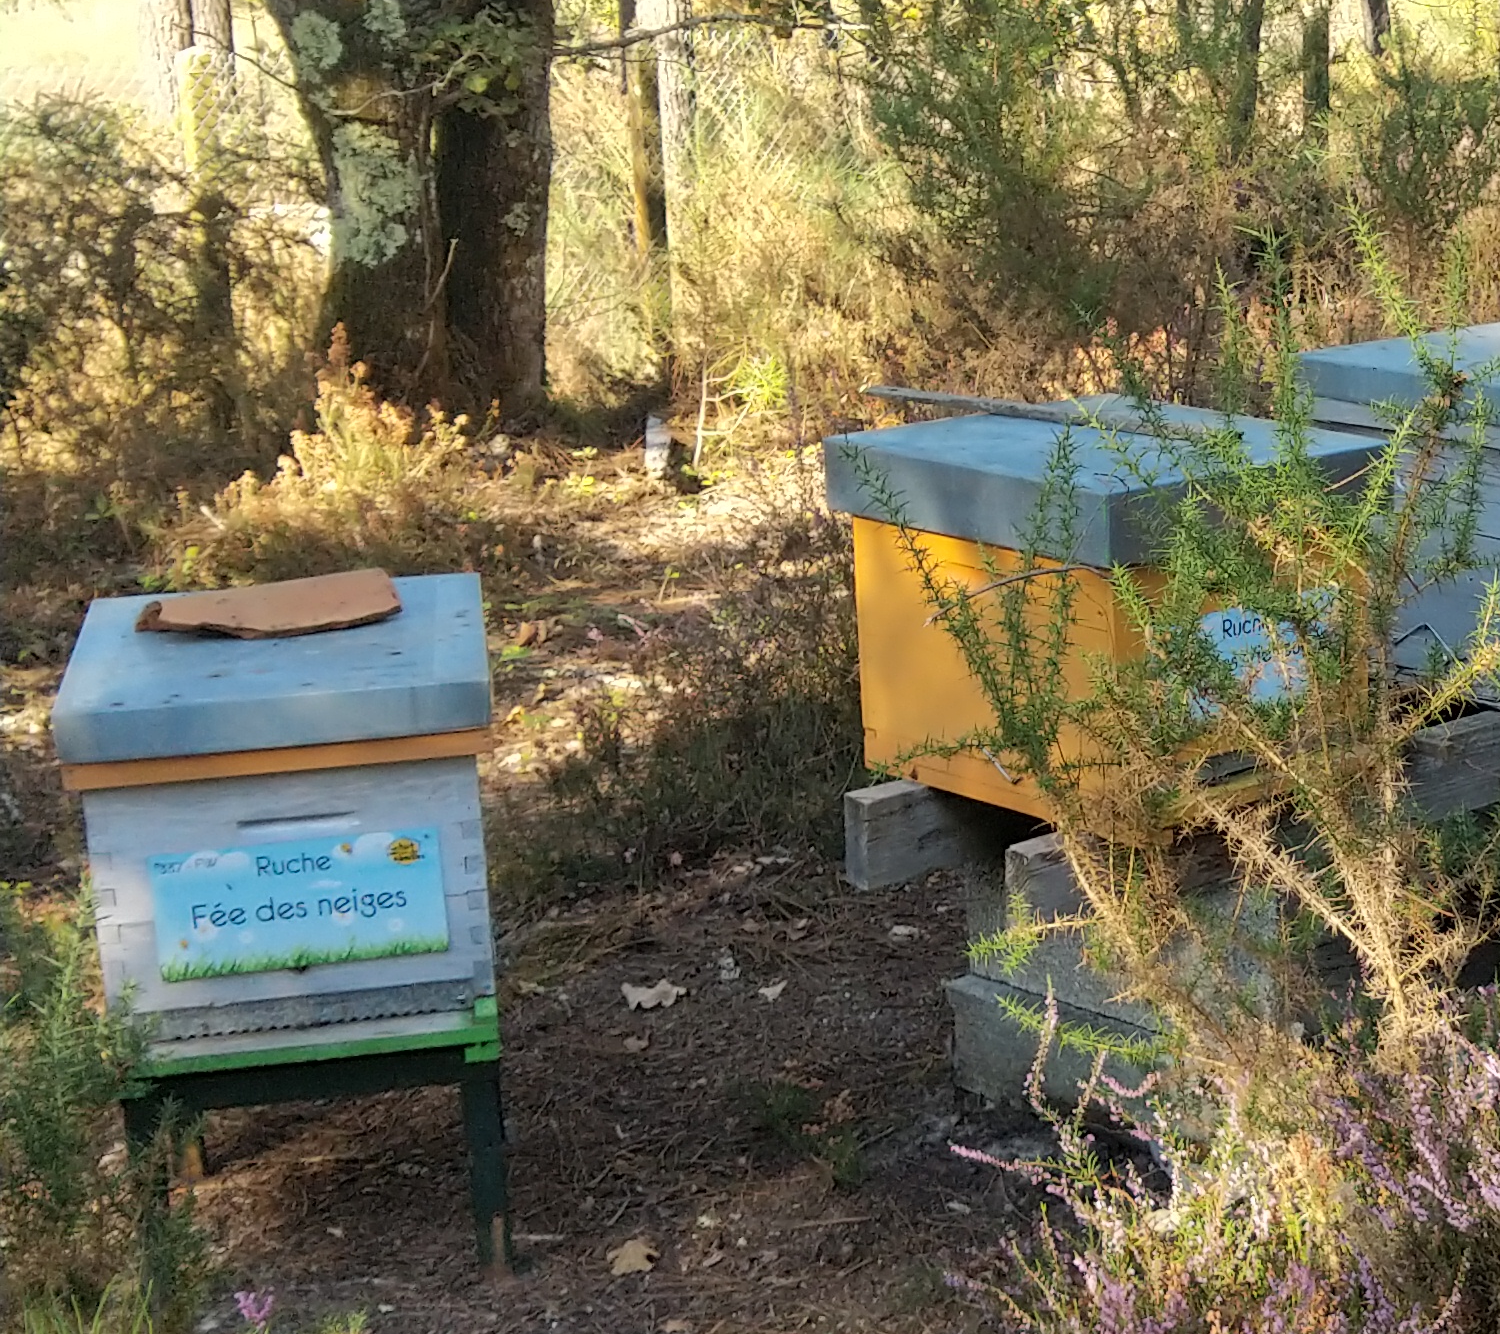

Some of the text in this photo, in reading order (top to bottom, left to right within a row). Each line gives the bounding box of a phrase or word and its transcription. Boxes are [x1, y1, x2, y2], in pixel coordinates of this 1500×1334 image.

[256, 852, 333, 877] Ruche
[191, 888, 408, 929] Fée des neiges
